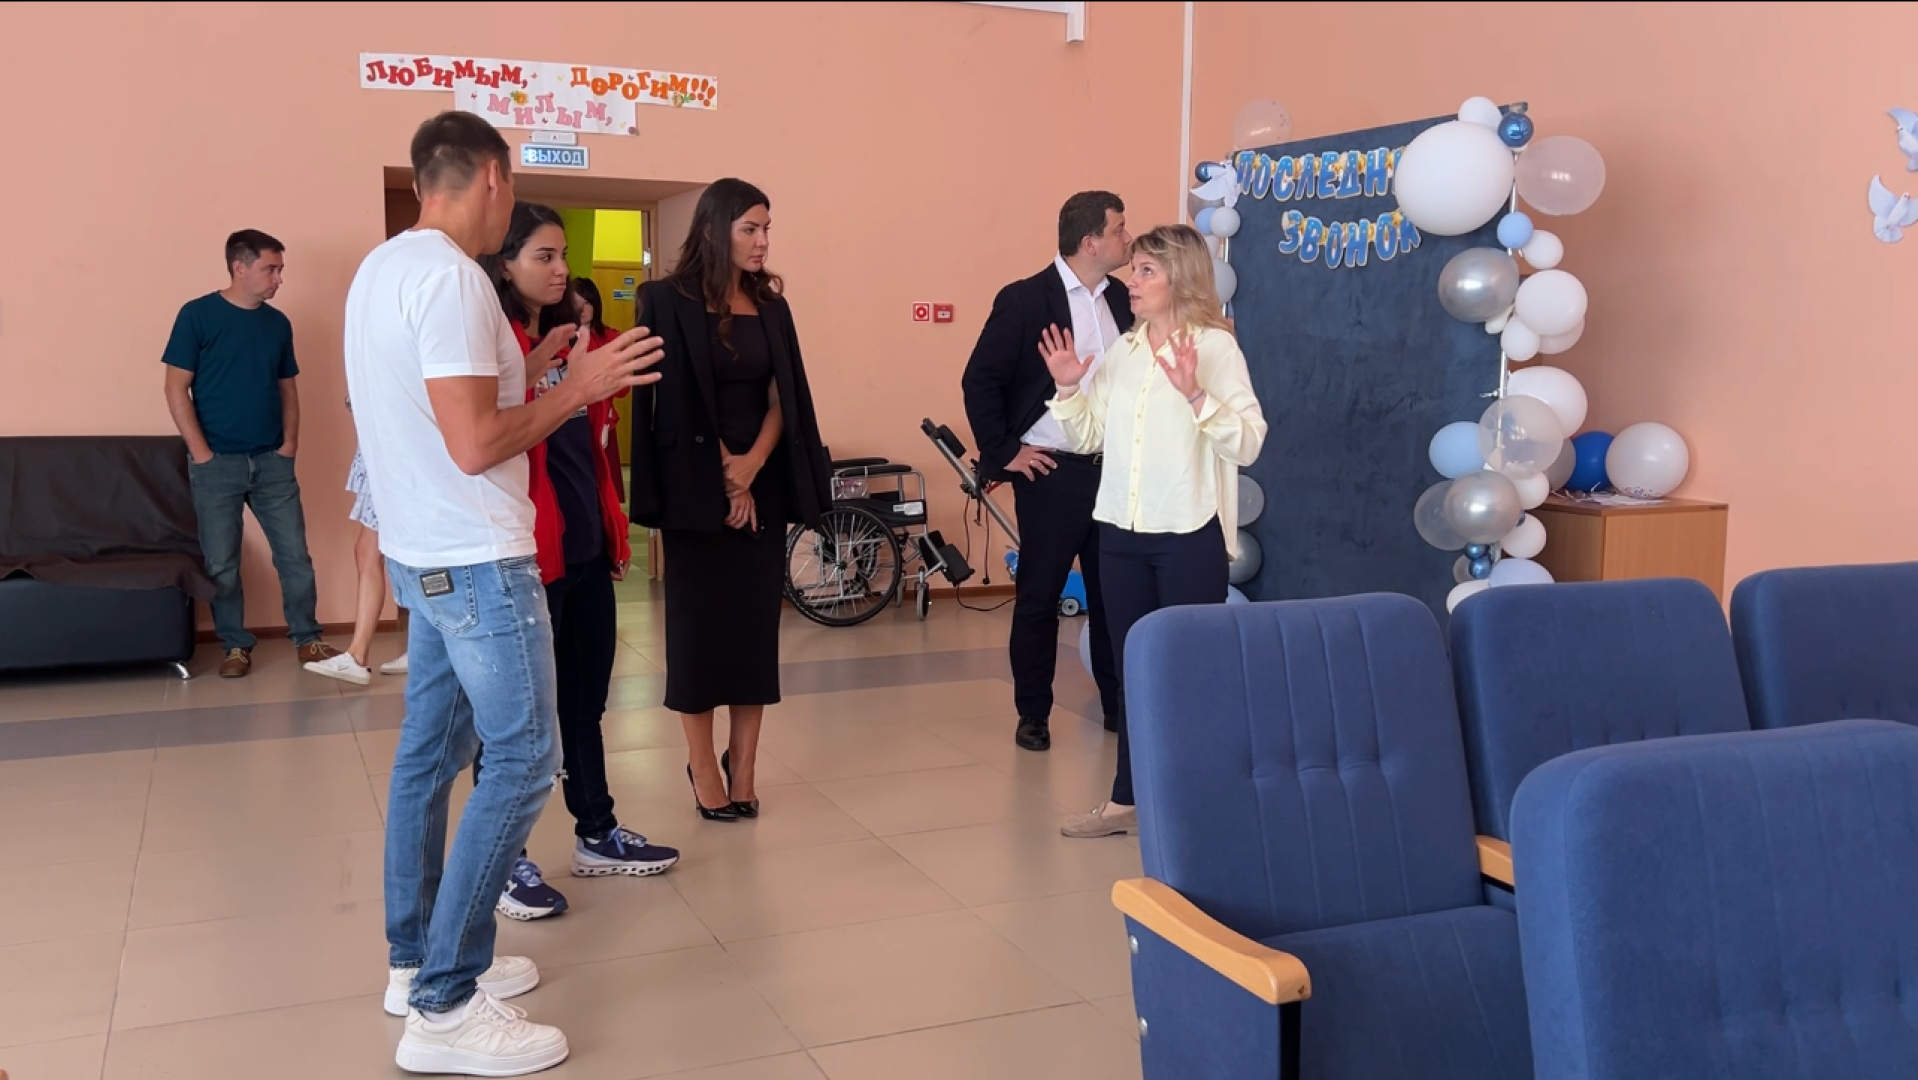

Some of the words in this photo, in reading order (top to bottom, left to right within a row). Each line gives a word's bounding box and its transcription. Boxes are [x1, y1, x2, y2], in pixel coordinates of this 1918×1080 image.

[365, 57, 528, 89] ЛЮБИМЫМ,
[487, 93, 613, 129] МИЛЫМ,
[527, 149, 582, 165] ВЫХОД
[1237, 147, 1402, 201] ПОСЛЕДН
